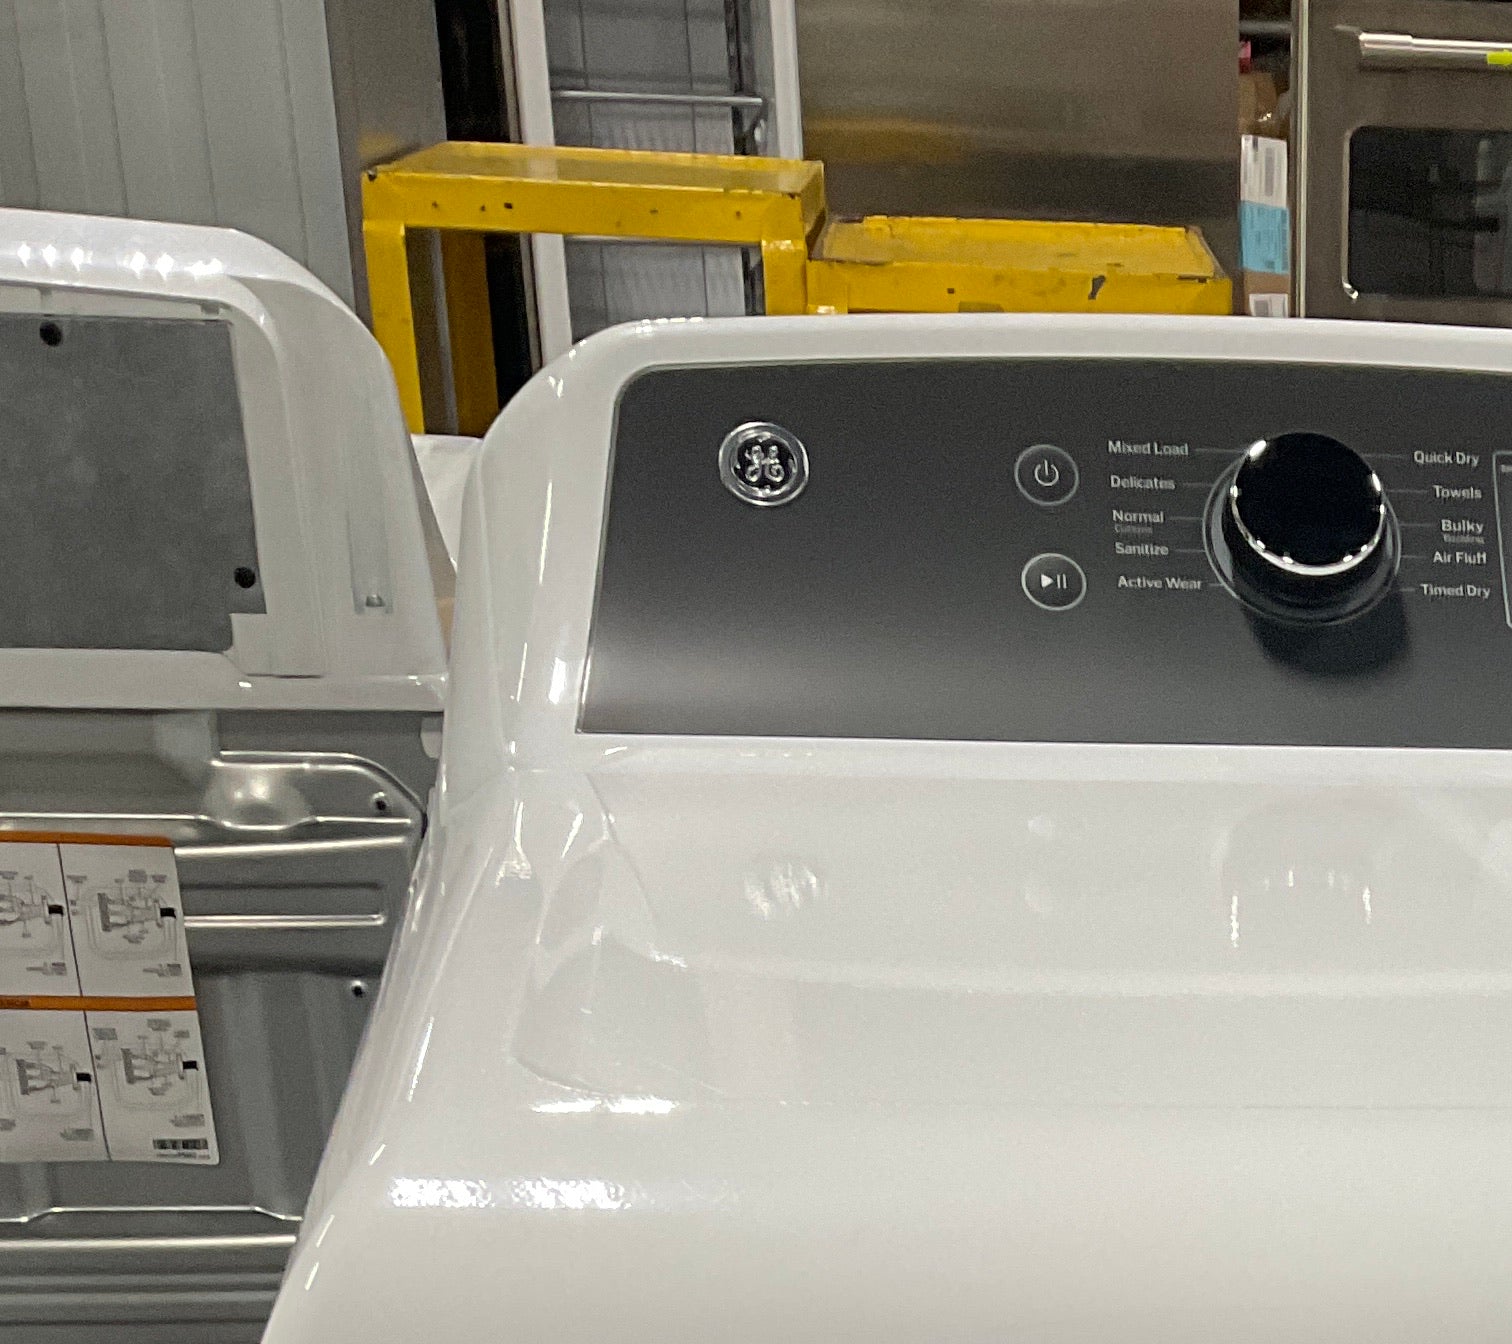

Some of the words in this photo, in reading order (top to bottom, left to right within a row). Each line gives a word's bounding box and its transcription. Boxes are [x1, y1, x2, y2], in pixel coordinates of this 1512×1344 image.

[1107, 440, 1150, 454] Mixed
[1154, 441, 1189, 456] Load
[1413, 450, 1452, 465] Quick
[1456, 451, 1480, 467] Dry
[1110, 474, 1176, 490] Delicates
[1432, 485, 1483, 499] Towels
[1112, 509, 1165, 523] Normal
[1441, 519, 1485, 534] Bulky
[1114, 542, 1169, 555] Sanitize
[1432, 551, 1452, 564] Air
[1456, 551, 1487, 564] Fluff
[1117, 575, 1163, 588] Active
[1165, 577, 1202, 590] Wear
[1420, 583, 1464, 597] Timed
[1466, 584, 1491, 600] Dry
